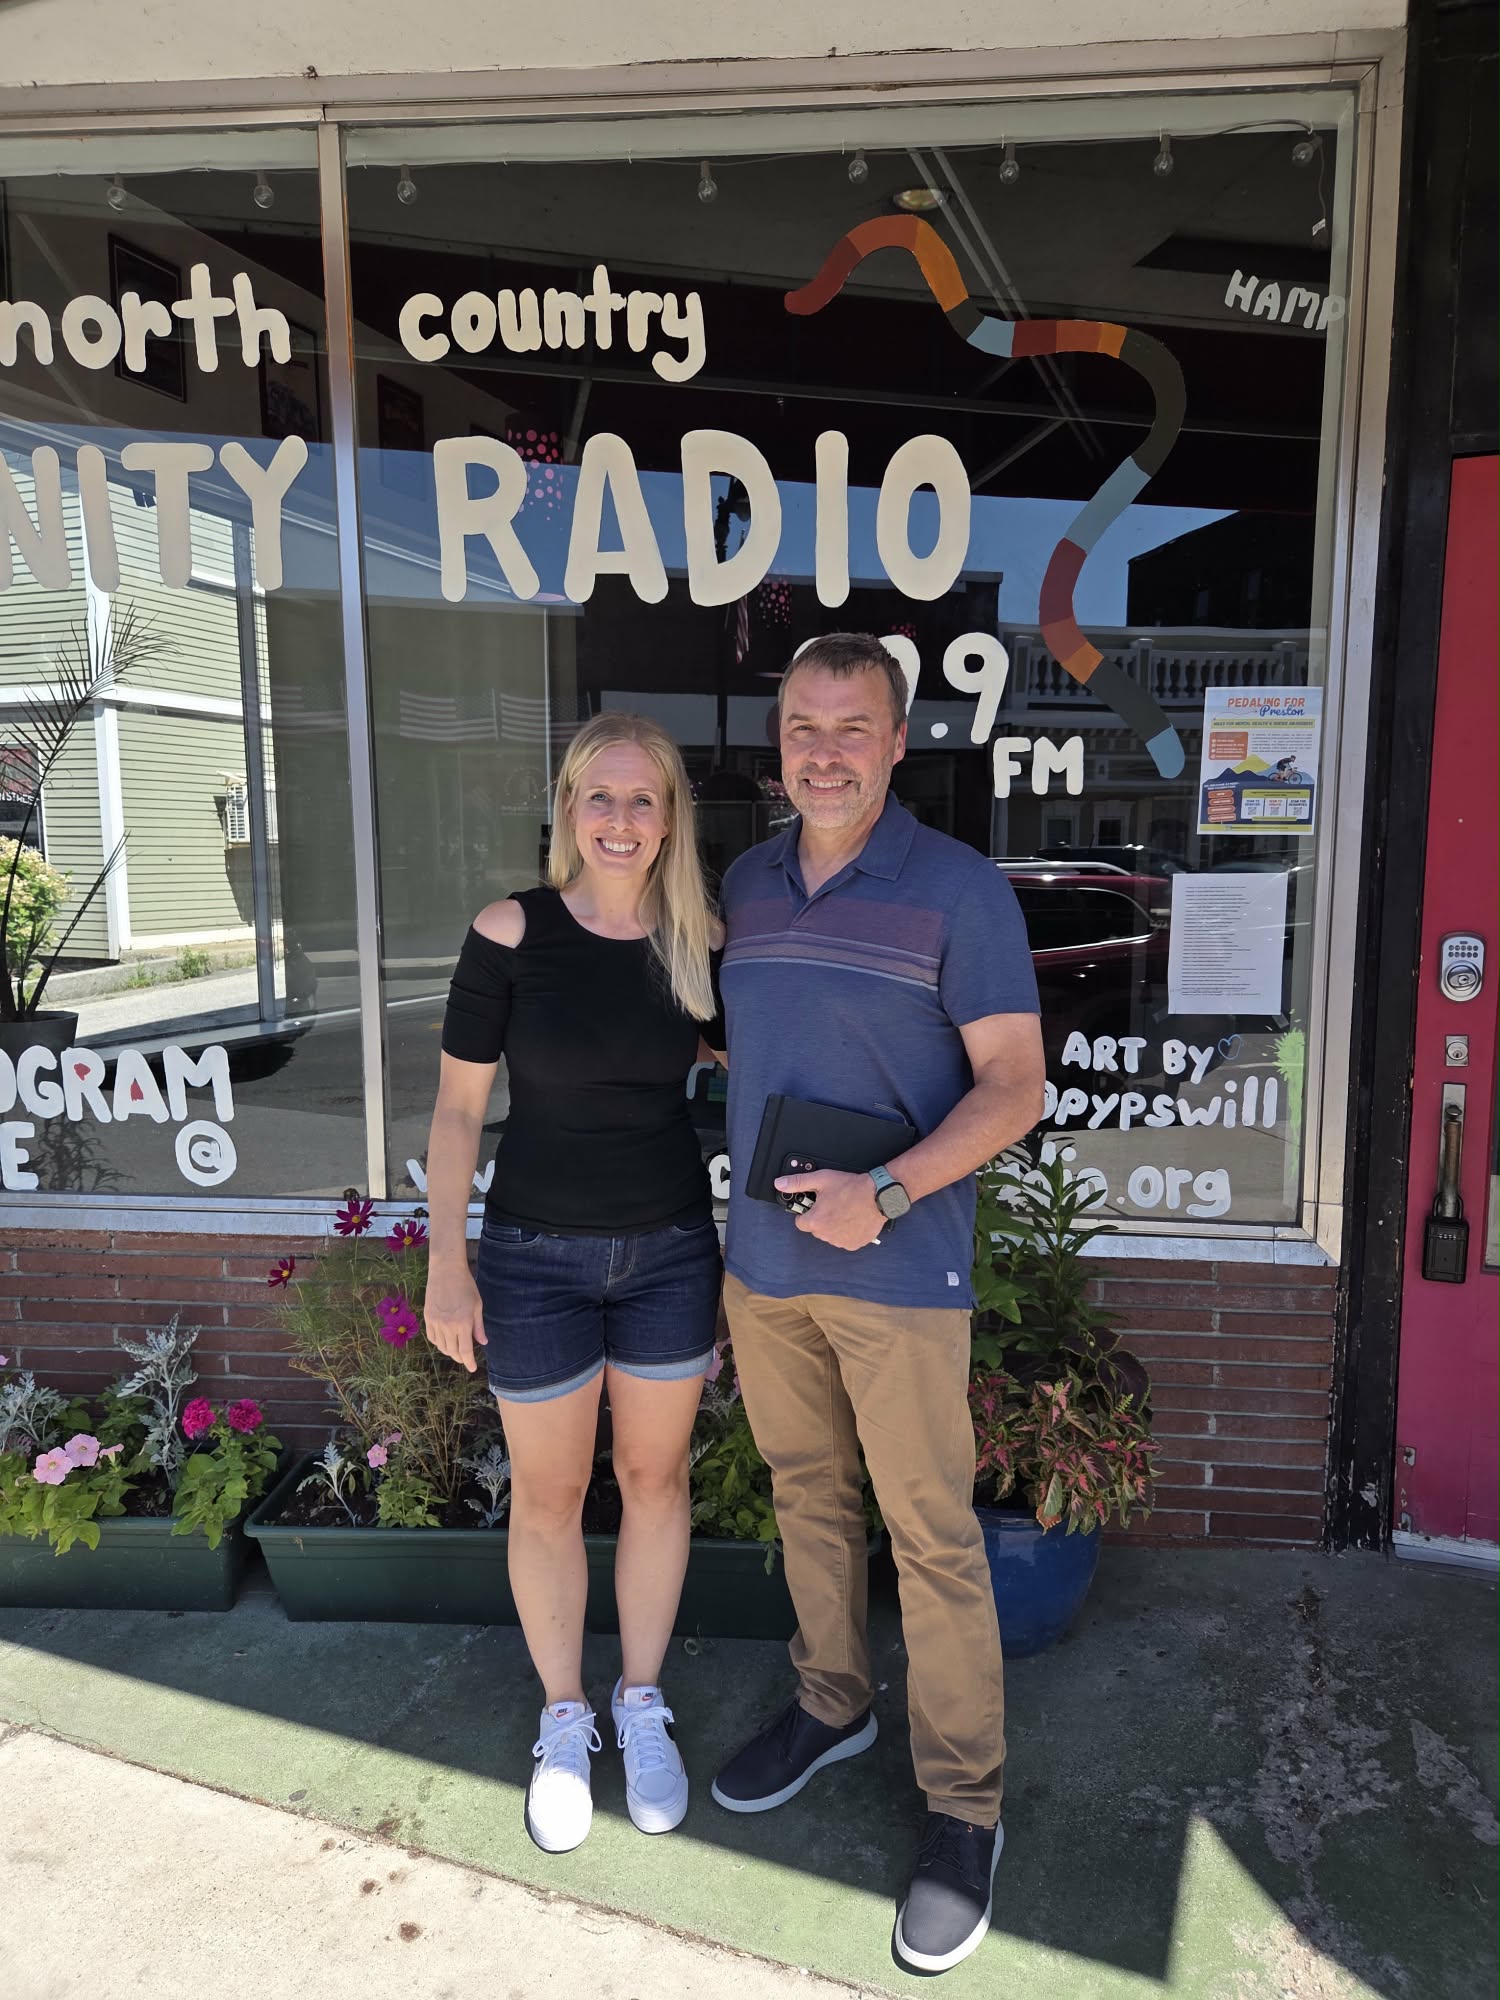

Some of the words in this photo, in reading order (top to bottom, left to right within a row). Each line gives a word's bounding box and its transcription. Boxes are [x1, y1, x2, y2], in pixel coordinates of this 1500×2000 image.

[0, 263, 291, 372] north
[399, 264, 706, 382] country
[1224, 269, 1346, 331] HAMP
[433, 429, 971, 608] RADIO
[1228, 697, 1280, 708] PEDALING
[1284, 697, 1305, 708] FOR
[1260, 704, 1305, 717] Preston
[993, 735, 1084, 799] FM
[1061, 1031, 1147, 1073] ART
[1162, 1039, 1214, 1085] BY
